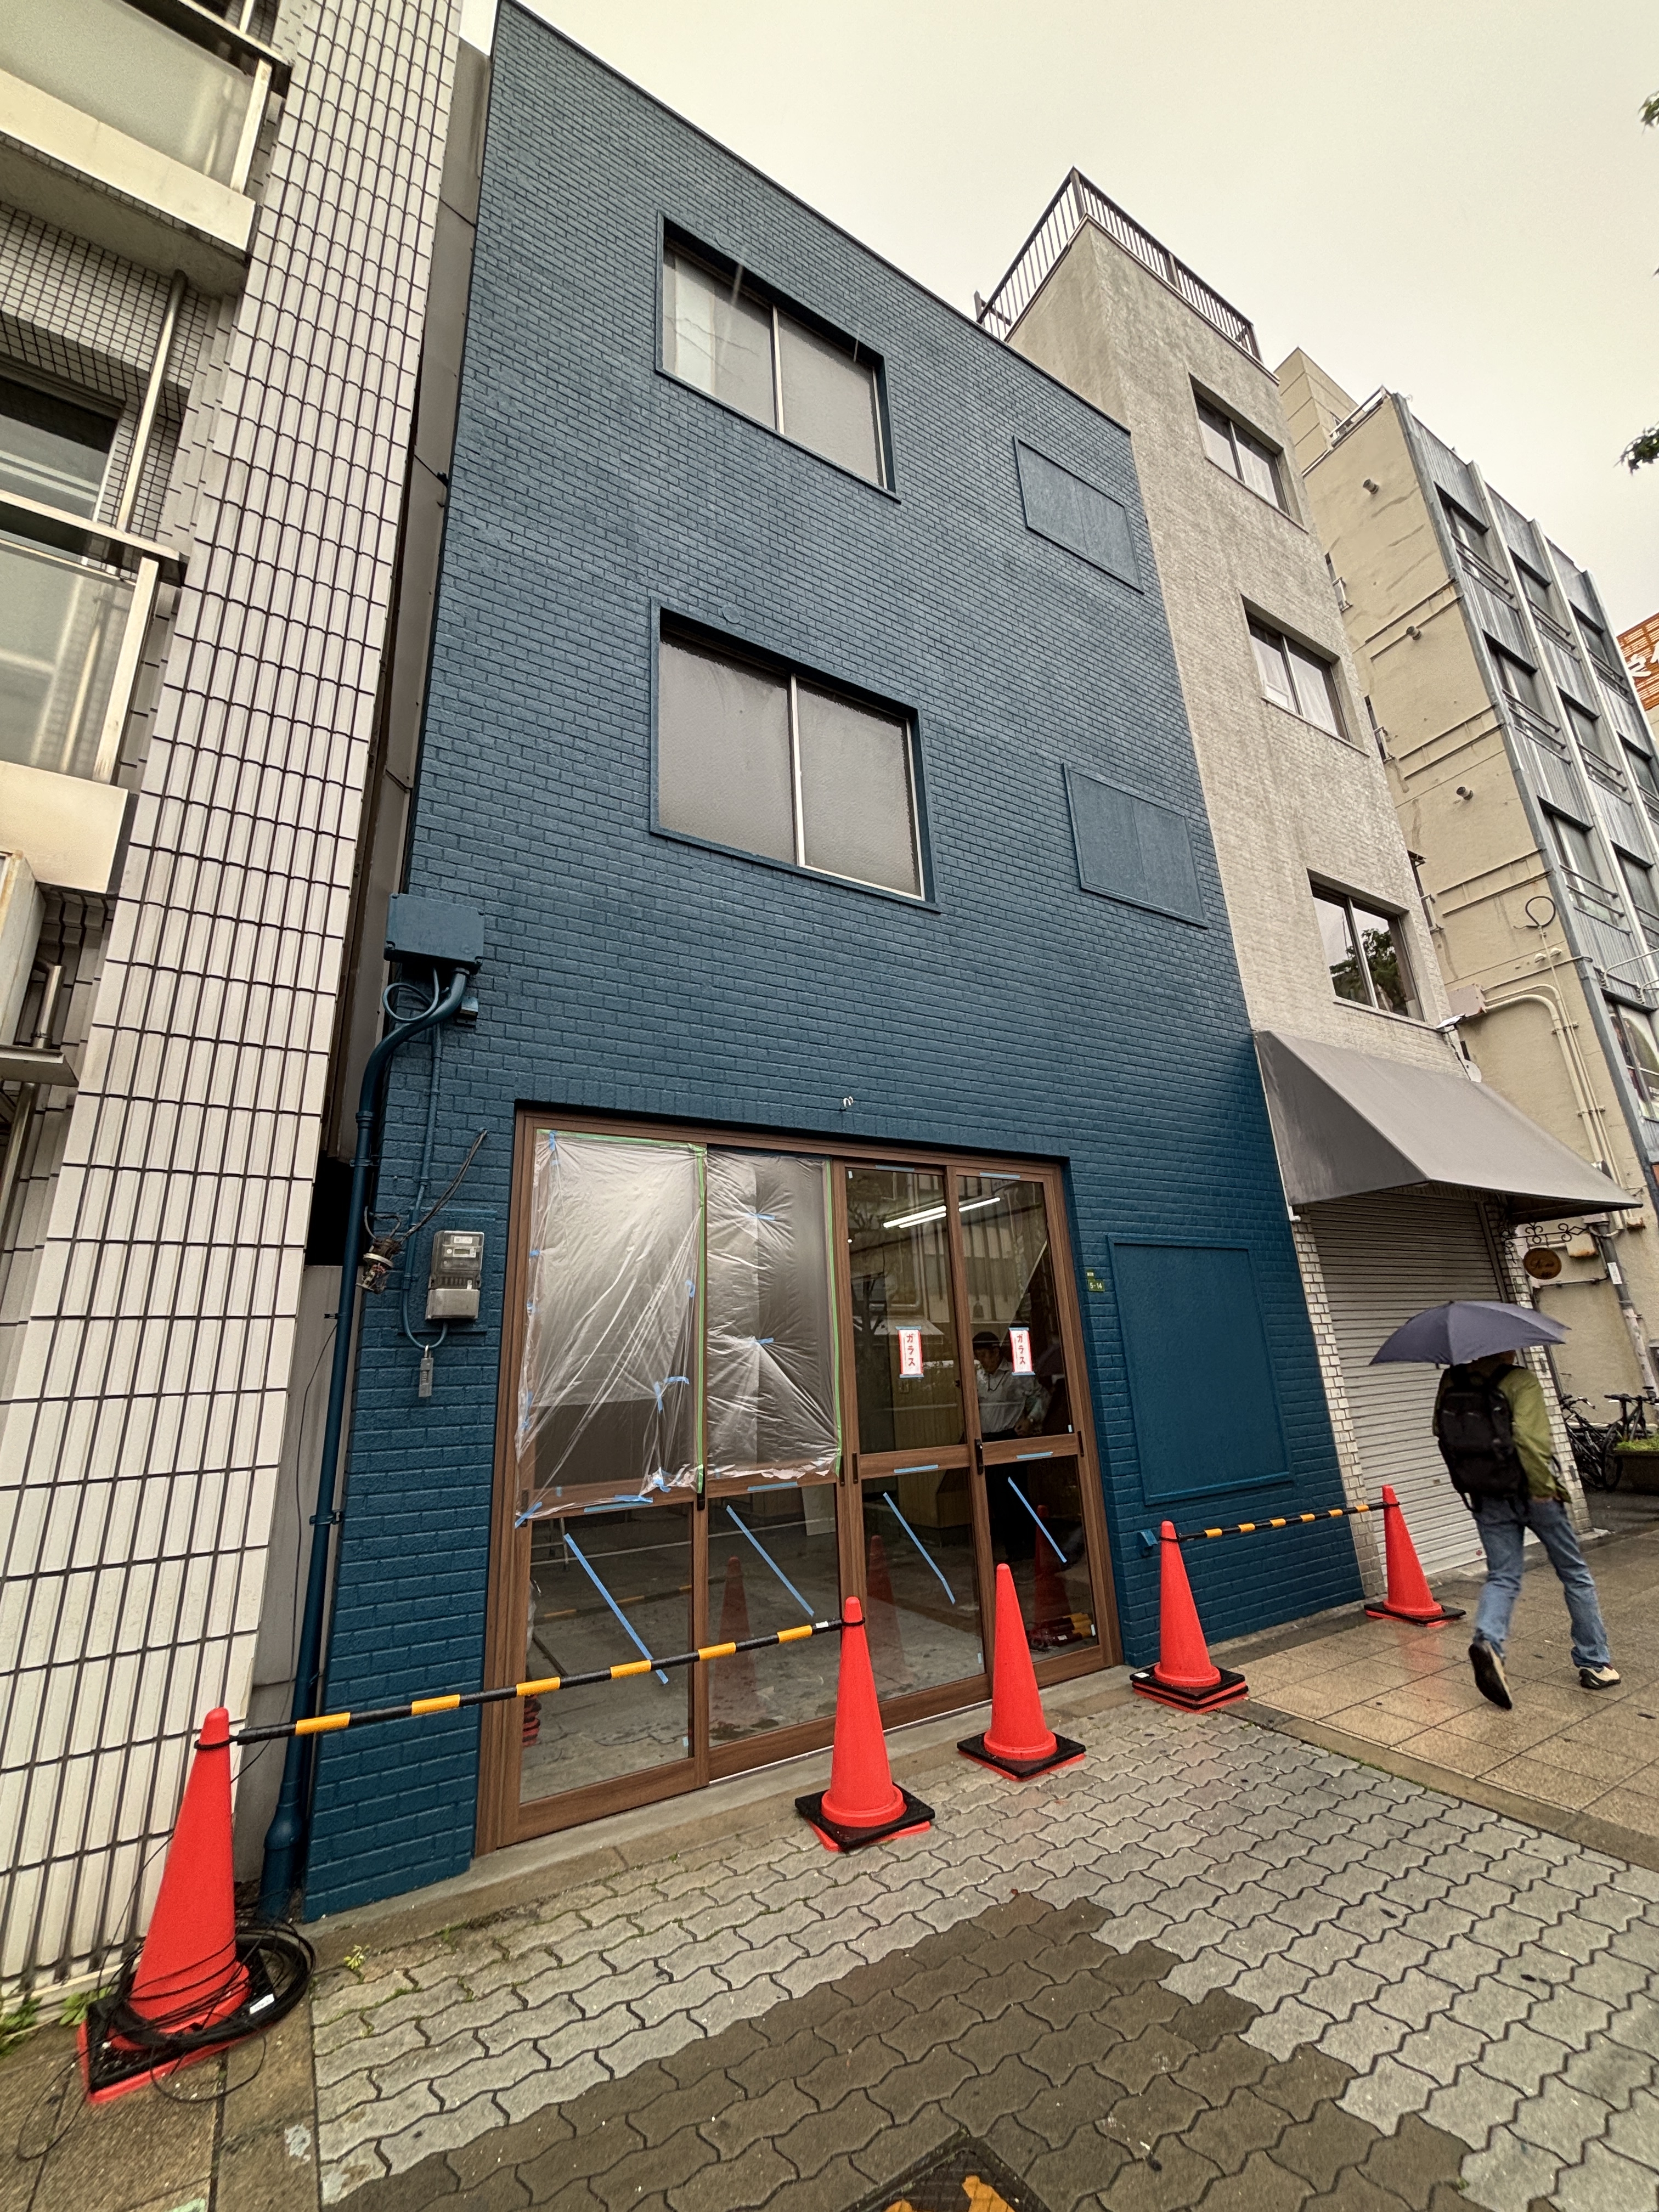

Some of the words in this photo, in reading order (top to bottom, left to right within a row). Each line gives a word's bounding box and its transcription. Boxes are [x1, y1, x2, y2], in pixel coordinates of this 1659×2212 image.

[906, 1333, 916, 1367] ガラス
[1017, 1333, 1026, 1365] ガラス
